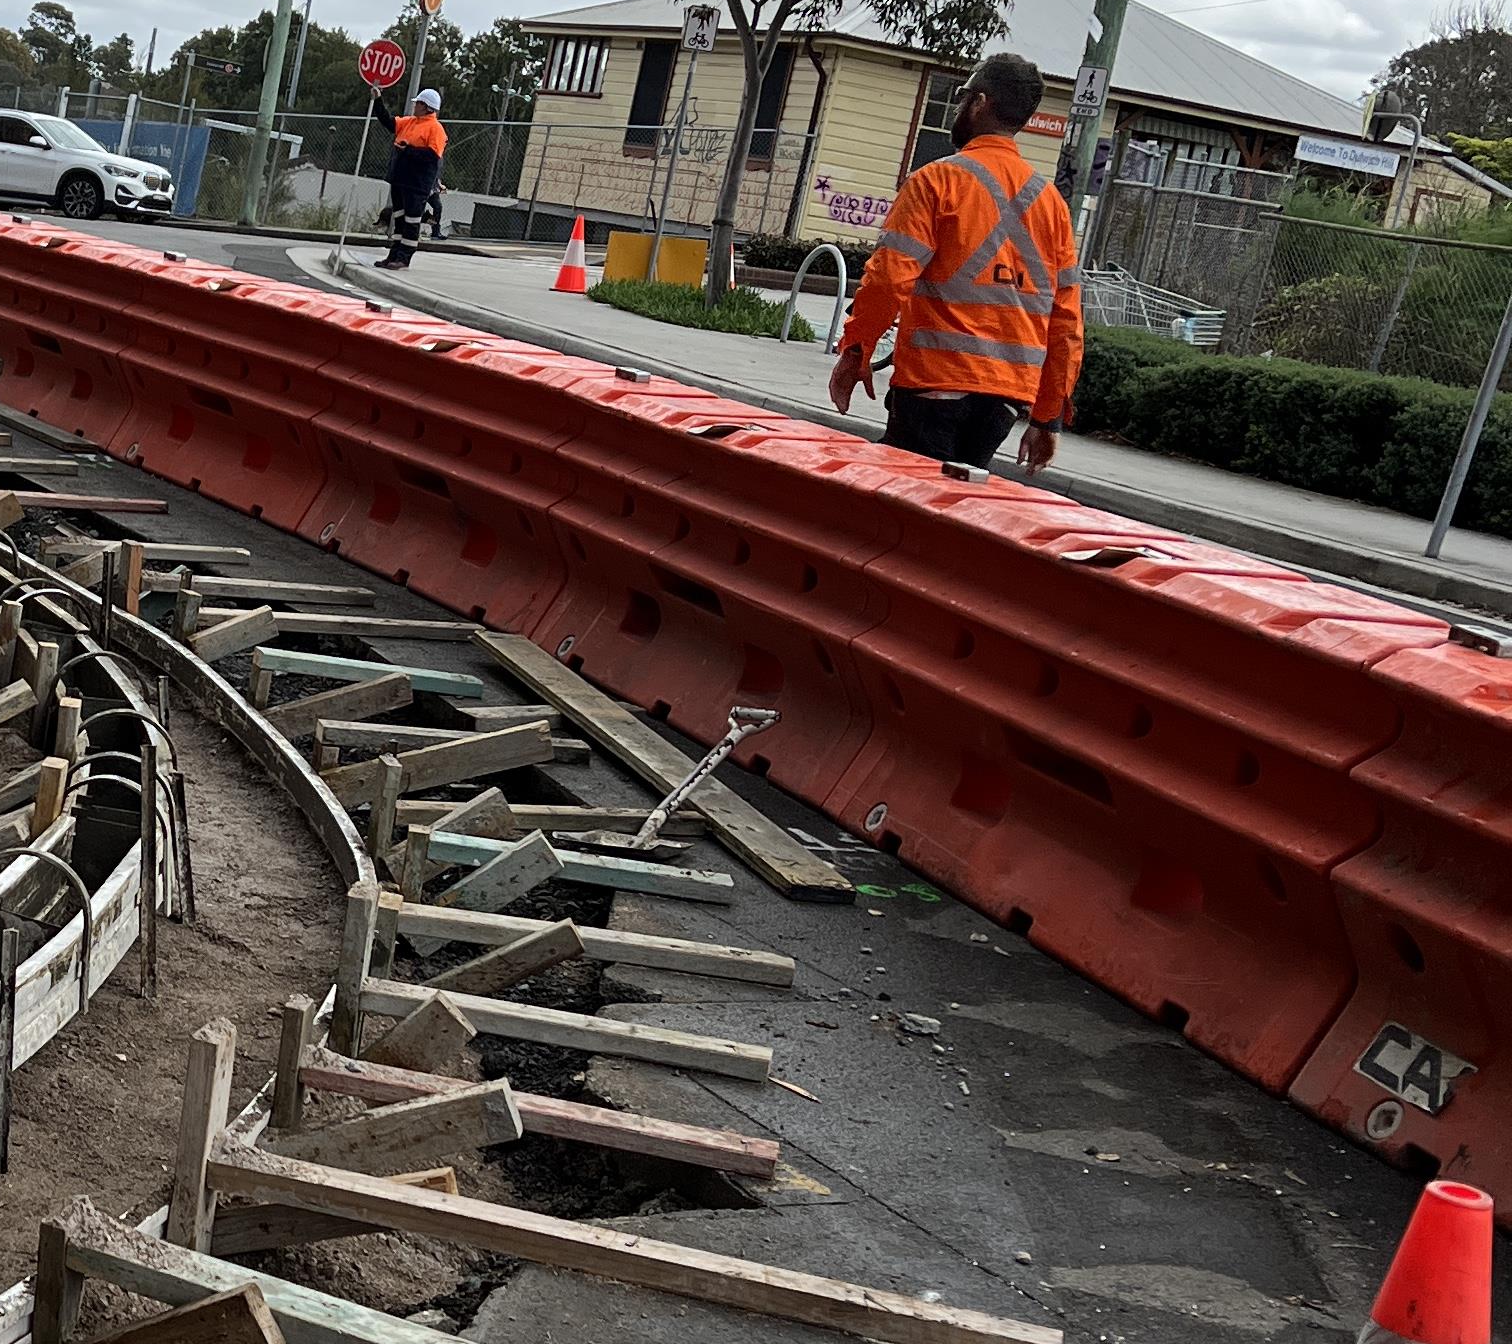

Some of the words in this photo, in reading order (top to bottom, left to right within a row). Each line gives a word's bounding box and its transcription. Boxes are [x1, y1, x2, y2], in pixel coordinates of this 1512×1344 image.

[361, 48, 403, 79] STOP
[1028, 116, 1062, 132] ulwich
[1300, 139, 1337, 158] Welcome
[1339, 147, 1349, 160] To
